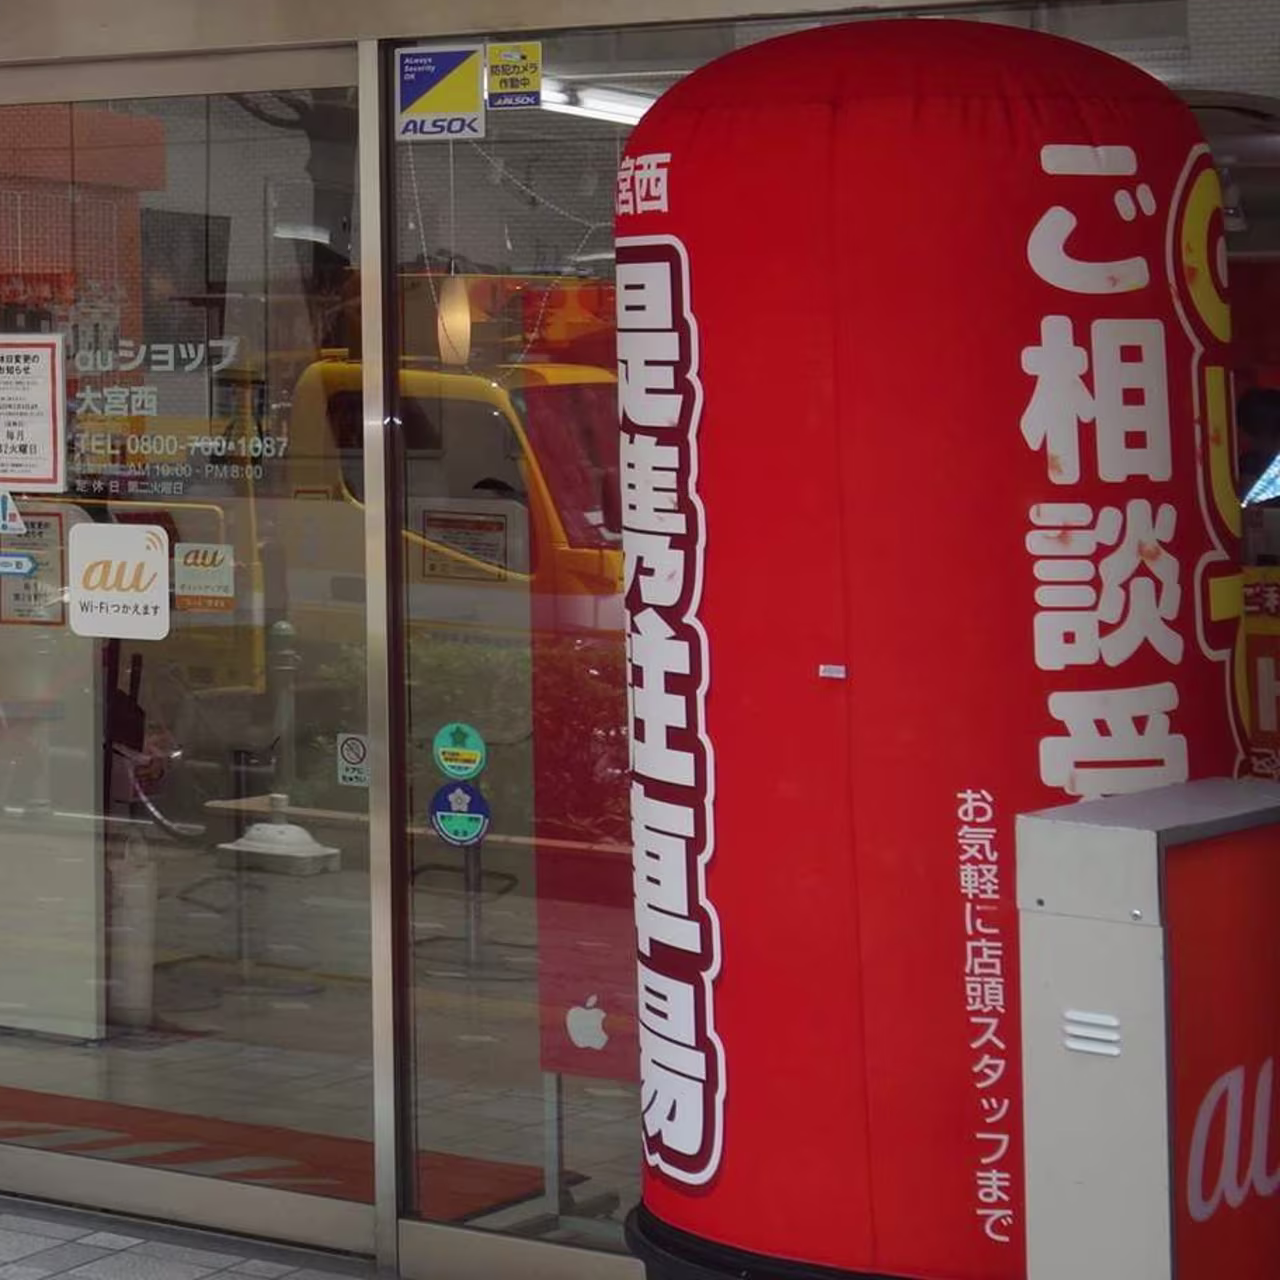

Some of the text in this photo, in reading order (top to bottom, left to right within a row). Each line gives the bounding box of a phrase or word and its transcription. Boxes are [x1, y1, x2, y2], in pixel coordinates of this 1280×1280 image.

[401, 117, 479, 136] ALSOK
[75, 337, 239, 372] auショップ
[75, 385, 158, 417] 大宮西
[76, 433, 120, 455] TEL
[184, 548, 225, 569] au
[81, 559, 159, 593] au
[80, 601, 161, 617] Wi-Fiつかえます
[957, 789, 1013, 1243] お気軽に店頭スタッフまで
